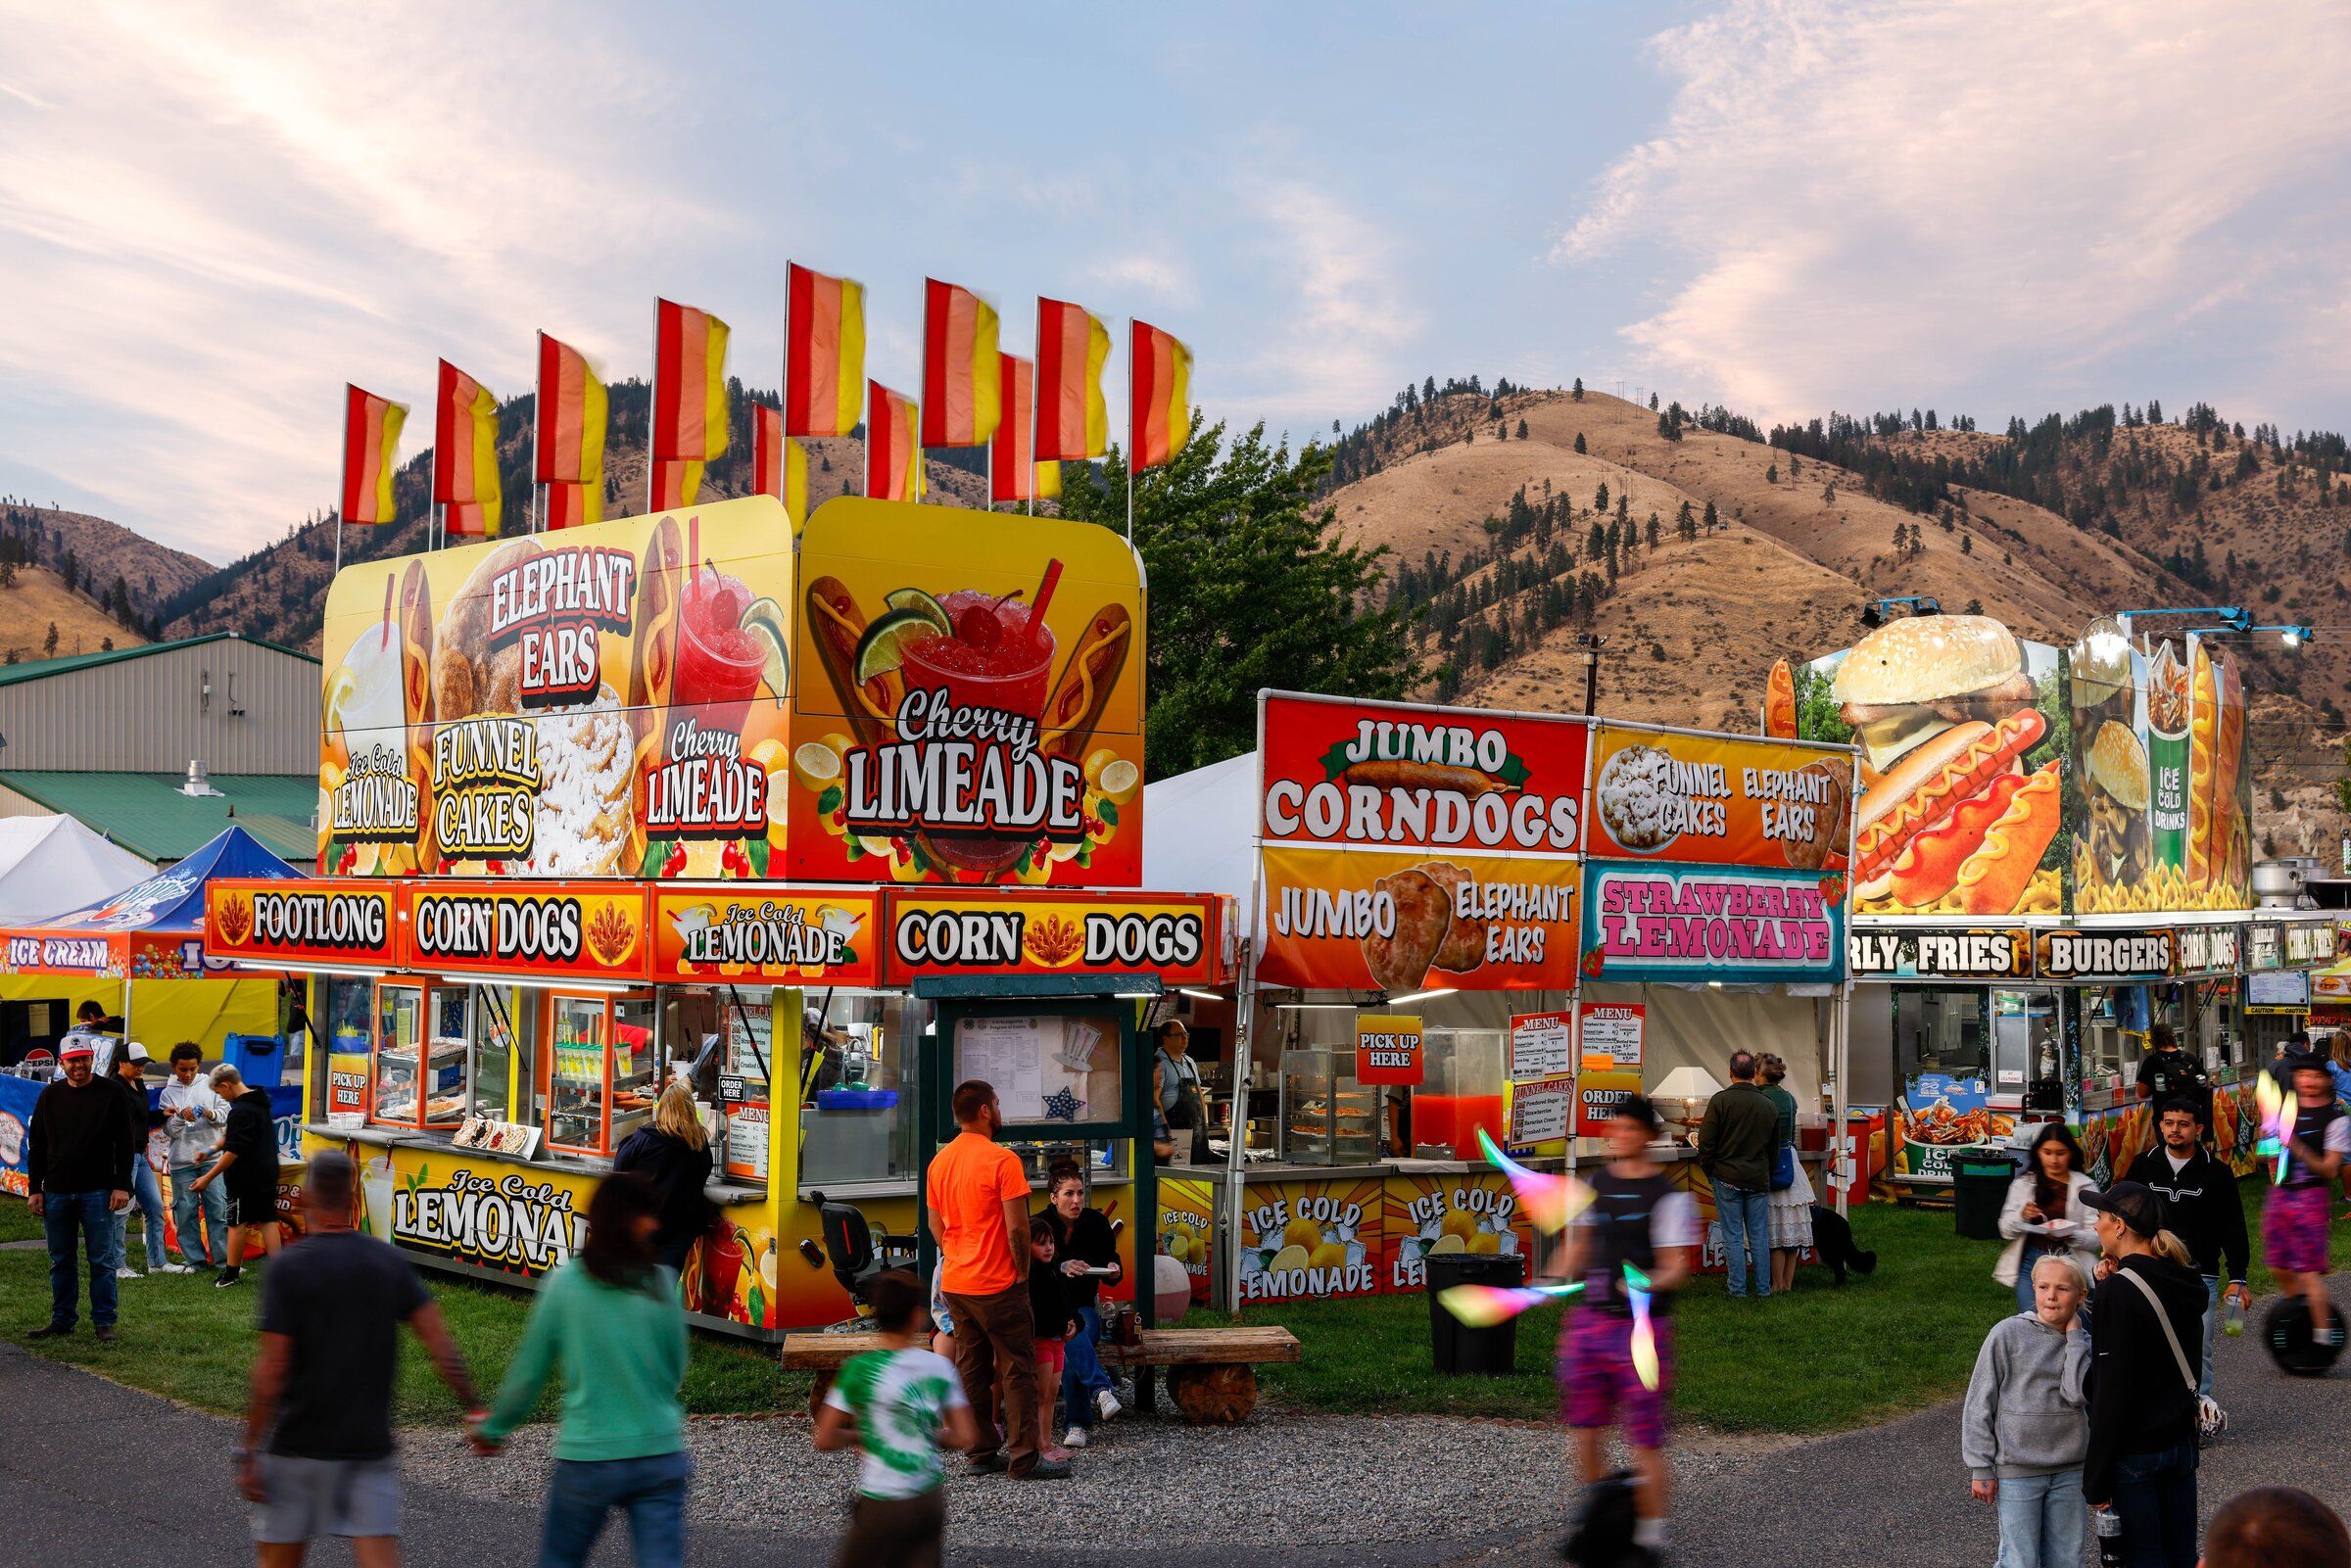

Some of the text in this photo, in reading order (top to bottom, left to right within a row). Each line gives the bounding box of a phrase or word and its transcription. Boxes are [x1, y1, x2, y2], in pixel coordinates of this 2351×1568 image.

[492, 551, 633, 635] ELEPHANT
[523, 627, 596, 688] EARS
[898, 689, 1038, 762] Cherry
[347, 742, 403, 779] Ice Cold
[435, 720, 539, 784] FUNNEL
[670, 719, 740, 771] Cherry
[1346, 720, 1508, 773] JUMBO
[647, 762, 762, 824] LIMEADE
[848, 741, 1080, 827] LIMEADE
[1655, 760, 1731, 798] FUNNEL
[1743, 767, 1831, 804] ELEPHANT
[2159, 766, 2180, 790] ICE
[333, 778, 416, 830] LEMONADE
[1266, 780, 1578, 849] CORNDOGS
[2158, 788, 2181, 809] COLD
[437, 791, 531, 847] CAKES
[1658, 800, 1726, 836] CAKES
[1761, 803, 1815, 841] EARS
[2155, 809, 2185, 831] DRINKS
[724, 902, 805, 926] Ice Cold
[1273, 881, 1574, 939] JUMBO ELEPHANT
[1603, 879, 1826, 919] STRAWBERRY
[254, 895, 385, 944] FOOTLONG
[418, 898, 579, 957] CORN DOGS
[1603, 916, 1829, 960] LEMONADE
[10, 938, 108, 968] ICE CREAM
[689, 922, 845, 965] LEMONADE
[898, 913, 1200, 964] CORN DOGS
[1486, 926, 1546, 964] EARS
[1850, 935, 2013, 972] RLY FRIES
[2050, 936, 2171, 973] BURGERS
[2181, 933, 2206, 969] CORN
[2211, 931, 2235, 967] DOGS
[729, 1006, 757, 1022] FUNEL
[1523, 1017, 1559, 1031] MENU
[1594, 1008, 1632, 1020] MENU
[1360, 1033, 1419, 1050] PICK UP
[1369, 1052, 1411, 1067] HERE
[332, 1072, 365, 1089] PICK UP
[337, 1090, 360, 1105] HERE
[721, 1080, 743, 1089] ORDER
[723, 1089, 741, 1098] HERE
[1515, 1080, 1574, 1099] FUNNEL CAKES
[1582, 1089, 1633, 1104] ORDER
[739, 1106, 770, 1122] MENU
[1587, 1107, 1616, 1120] HER
[1922, 1159, 1953, 1169] COL
[449, 1169, 572, 1212] Ice Cold
[1407, 1188, 1513, 1224] ICE COLD
[395, 1192, 591, 1266] LEMONA
[1163, 1211, 1208, 1229] ICE COLD
[1247, 1197, 1362, 1234] ICE COLD
[1184, 1264, 1208, 1276] NADE
[1239, 1263, 1374, 1300] EMONADE
